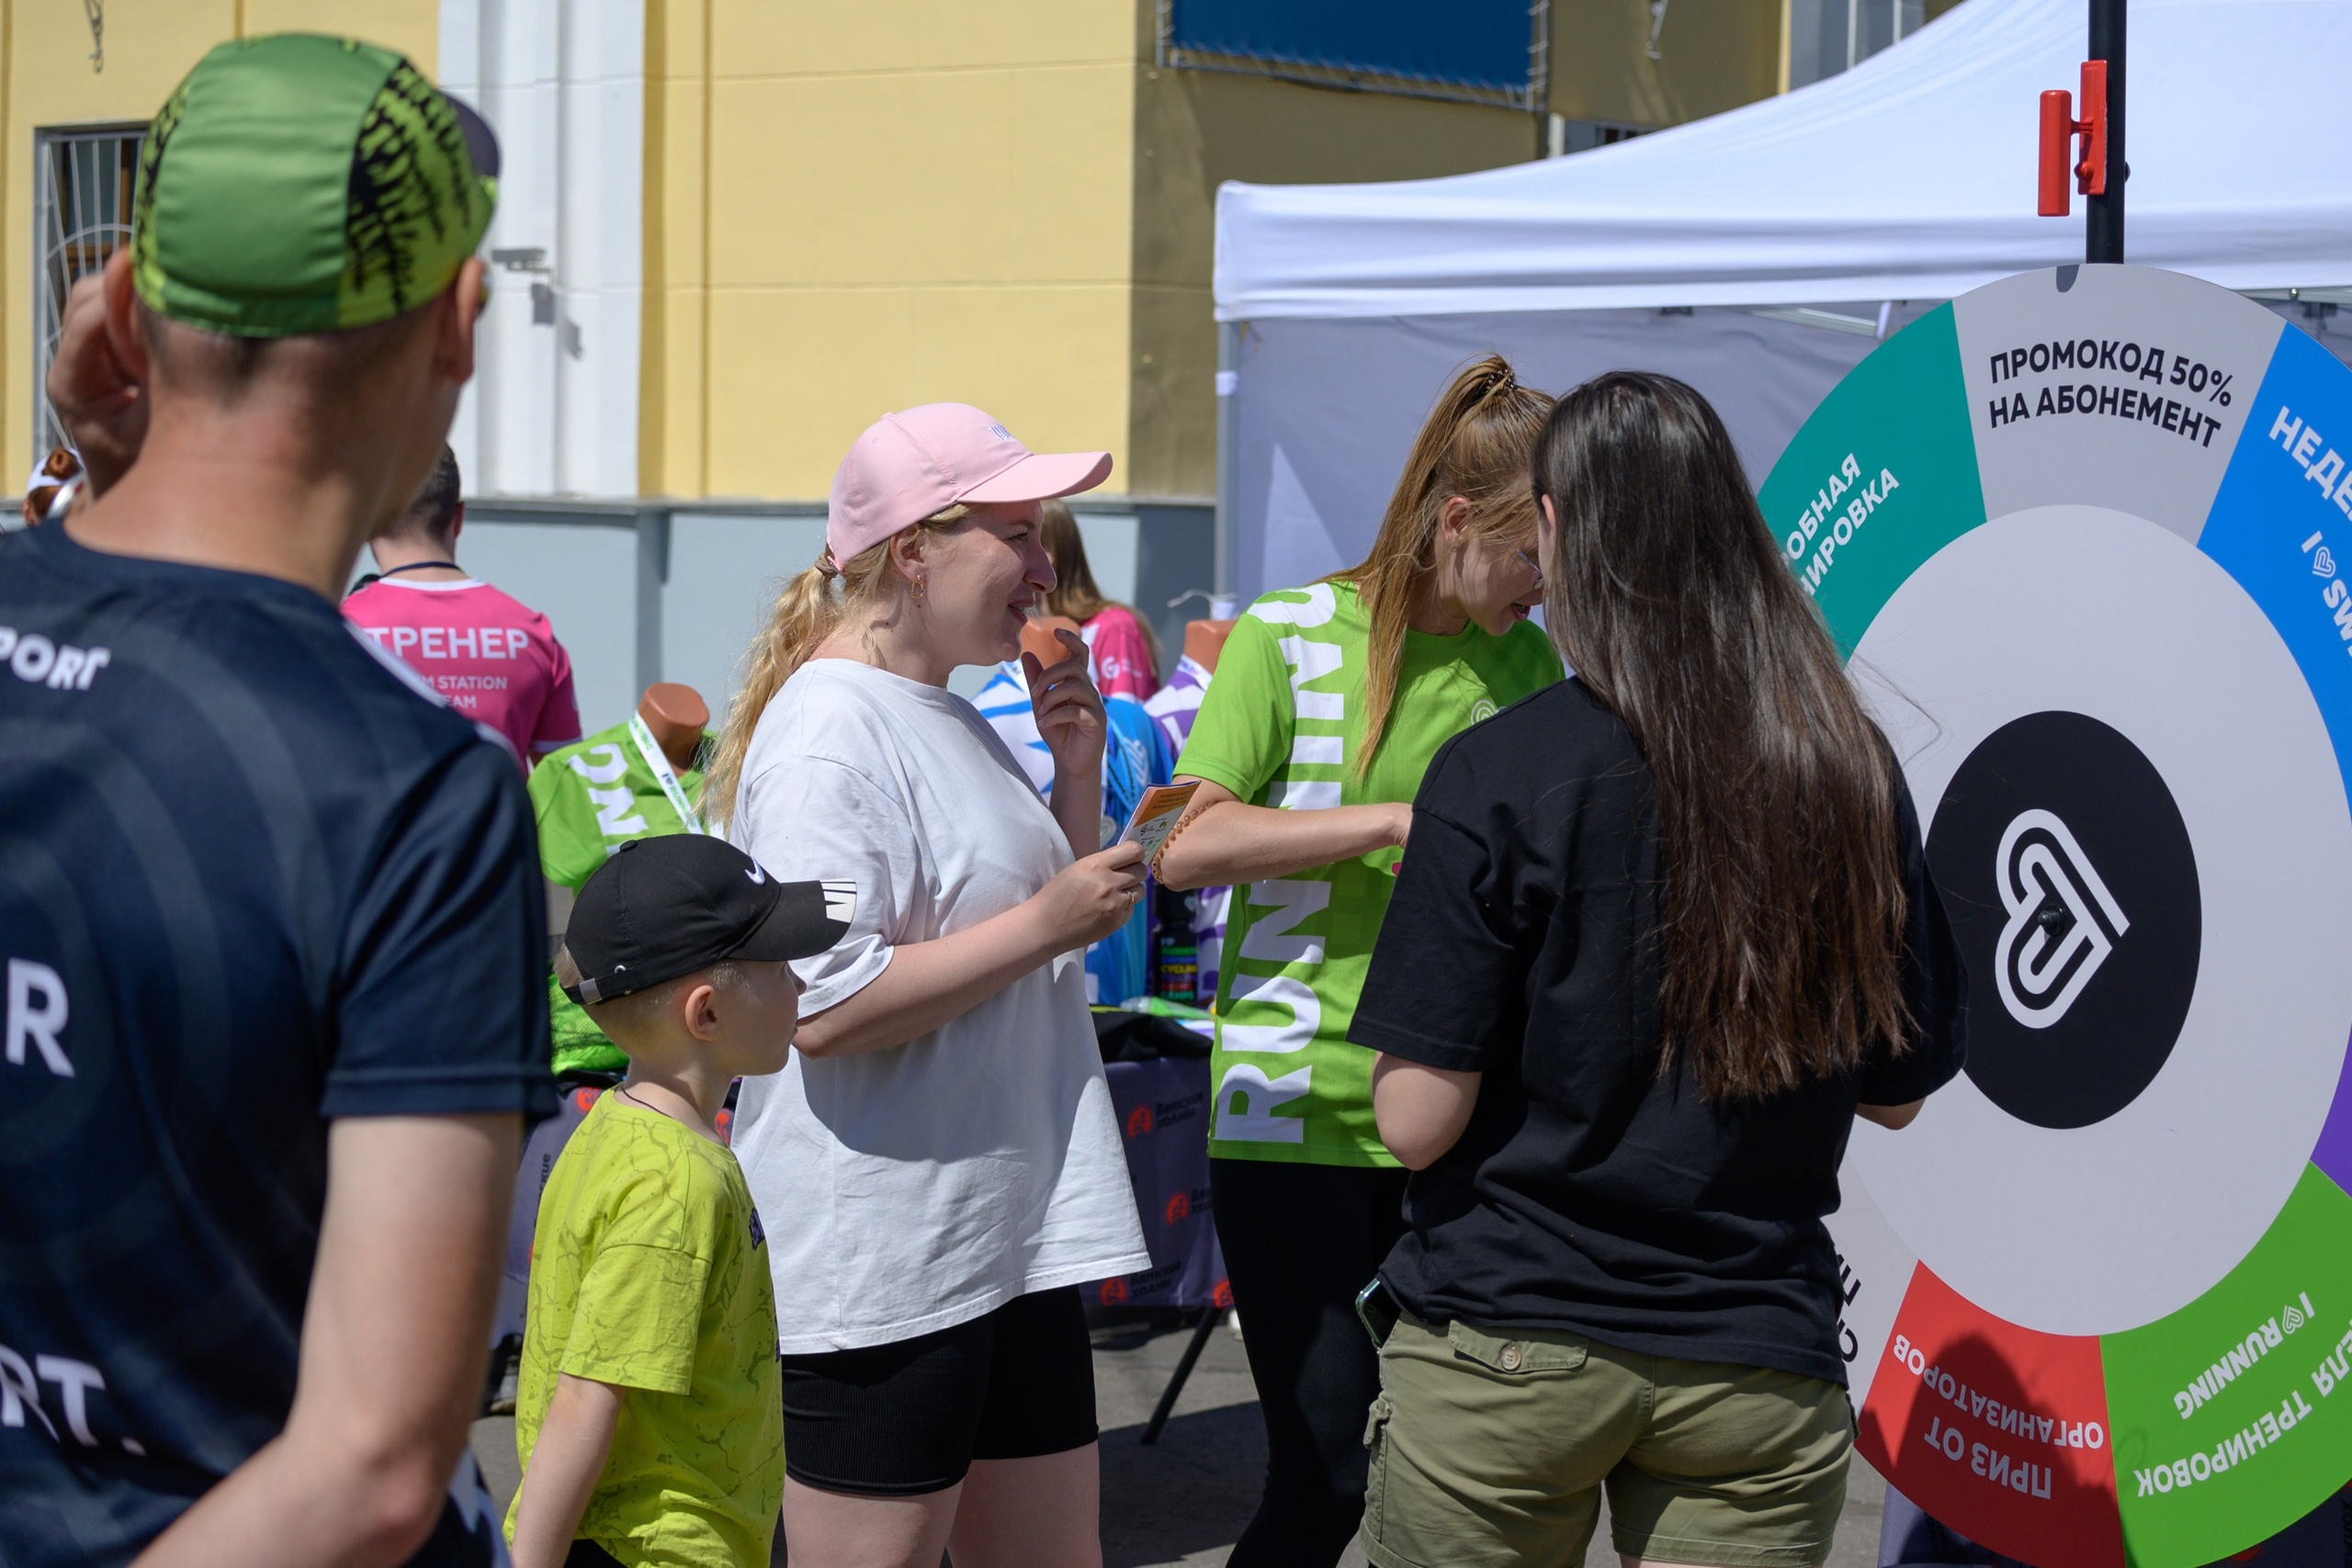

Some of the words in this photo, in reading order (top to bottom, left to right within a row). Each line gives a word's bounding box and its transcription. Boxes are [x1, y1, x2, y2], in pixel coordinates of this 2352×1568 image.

[1990, 339, 2165, 385] ПРОМОКОД
[2169, 355, 2233, 407] 50%
[1989, 392, 2030, 429] НА
[2035, 384, 2222, 448] АБОНЕМЕНТ
[2268, 405, 2352, 523] НЕДЕ
[1781, 452, 1861, 567] ОБНАЯ
[1800, 468, 1900, 596] НИРОВКА
[363, 626, 530, 660] ТРЕНЕР
[438, 675, 507, 690] STATION
[447, 695, 477, 708] EAM
[1893, 1334, 2104, 1450] ОРГАНИЗАТОРОВ
[2173, 1316, 2284, 1420] RUNNING
[1924, 1416, 1965, 1461] ОТ
[1971, 1442, 2052, 1500] ПРИЗ
[2133, 1390, 2312, 1497] ТРЕНИРОВОК
